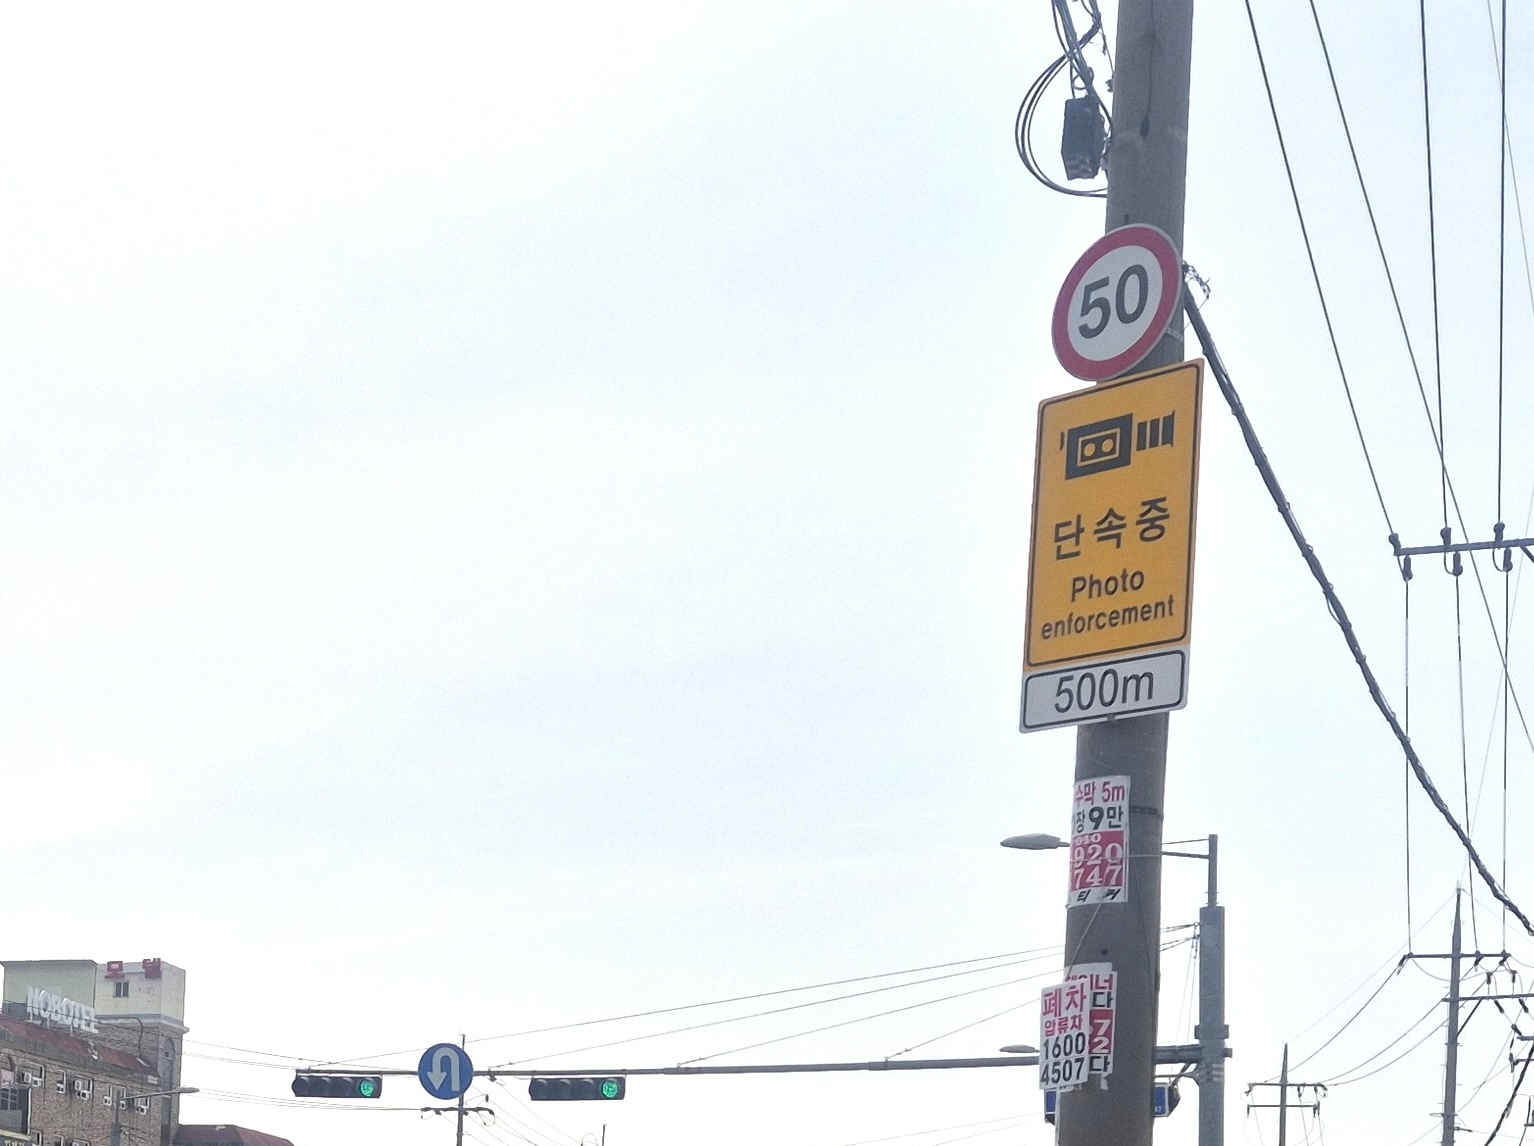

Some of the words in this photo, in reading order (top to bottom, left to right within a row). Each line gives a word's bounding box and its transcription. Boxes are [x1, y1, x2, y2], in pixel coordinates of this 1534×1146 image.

[1078, 264, 1149, 339] 50
[1054, 497, 1170, 560] 단속중
[1071, 568, 1145, 603] Photo
[1041, 594, 1175, 640] enforcement
[1054, 668, 1155, 714] 500m
[1102, 781, 1125, 803] 5m
[1042, 983, 1087, 1018] 폐차
[1044, 1014, 1084, 1037] 압류차
[1043, 1031, 1086, 1061] 1600
[1040, 1057, 1085, 1086] 4507
